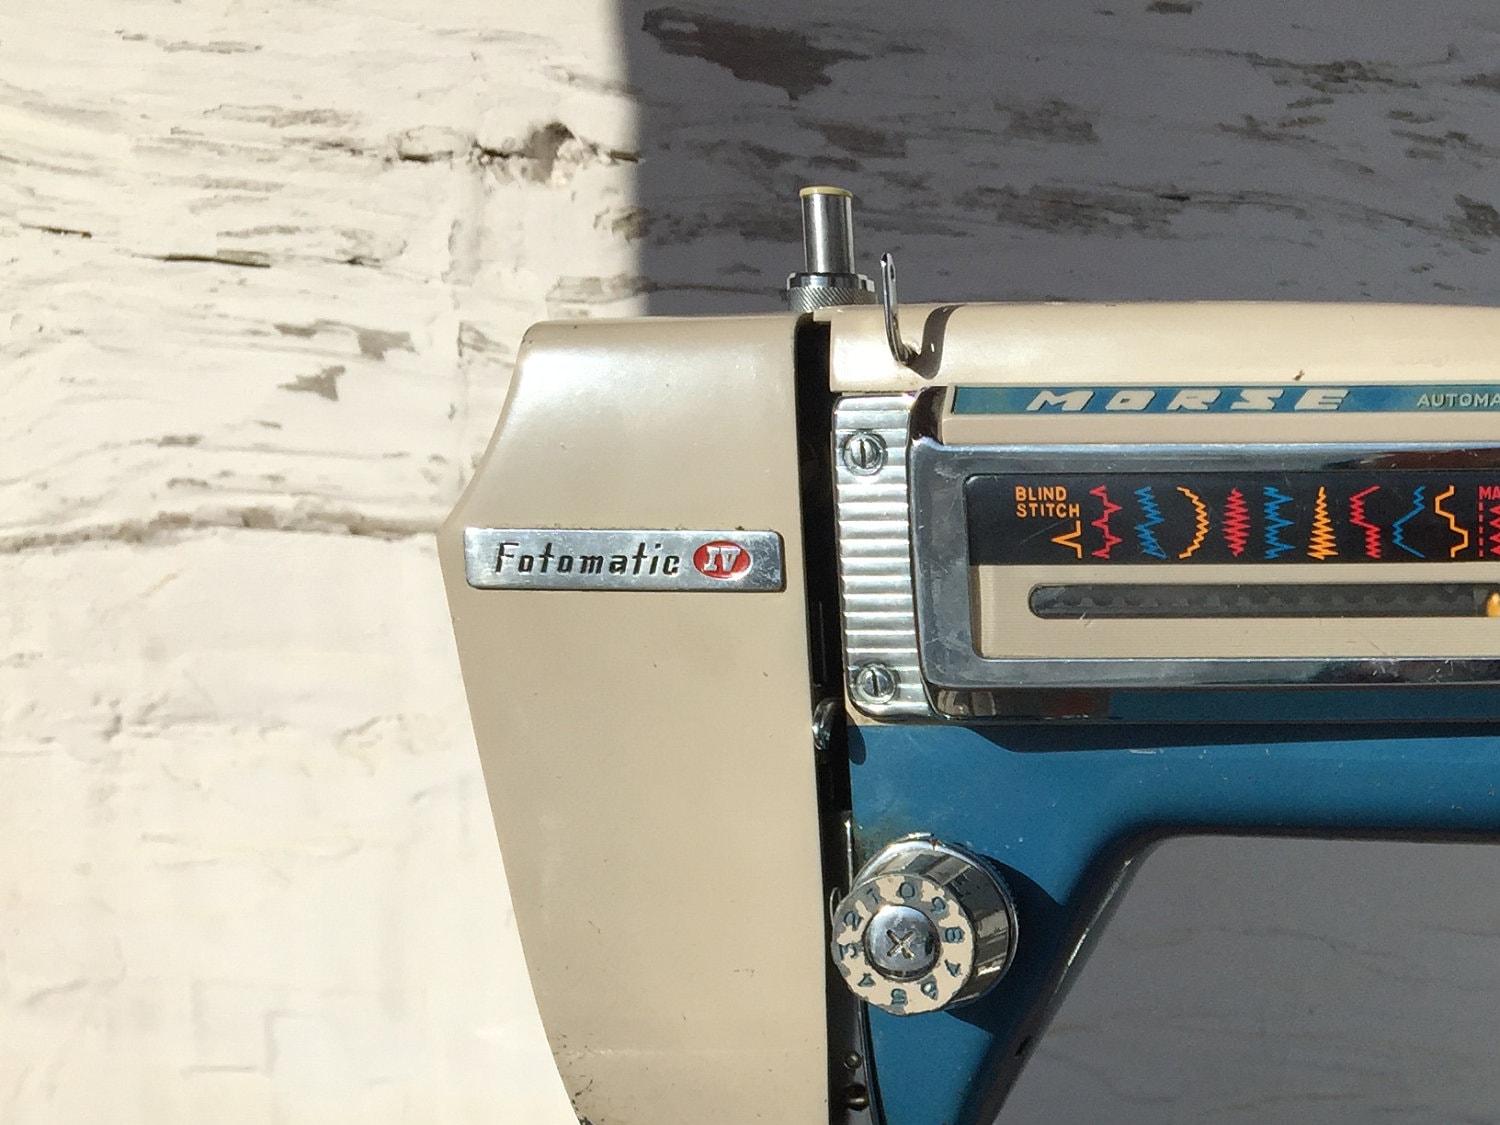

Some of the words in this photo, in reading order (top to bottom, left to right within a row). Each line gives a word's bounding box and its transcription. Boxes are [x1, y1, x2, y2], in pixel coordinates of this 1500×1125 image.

[1026, 389, 1350, 412] MORSE
[1015, 486, 1067, 501] BLIND
[1016, 503, 1080, 517] STITCH
[495, 542, 680, 576] Fotomatic
[703, 547, 742, 572] IV
